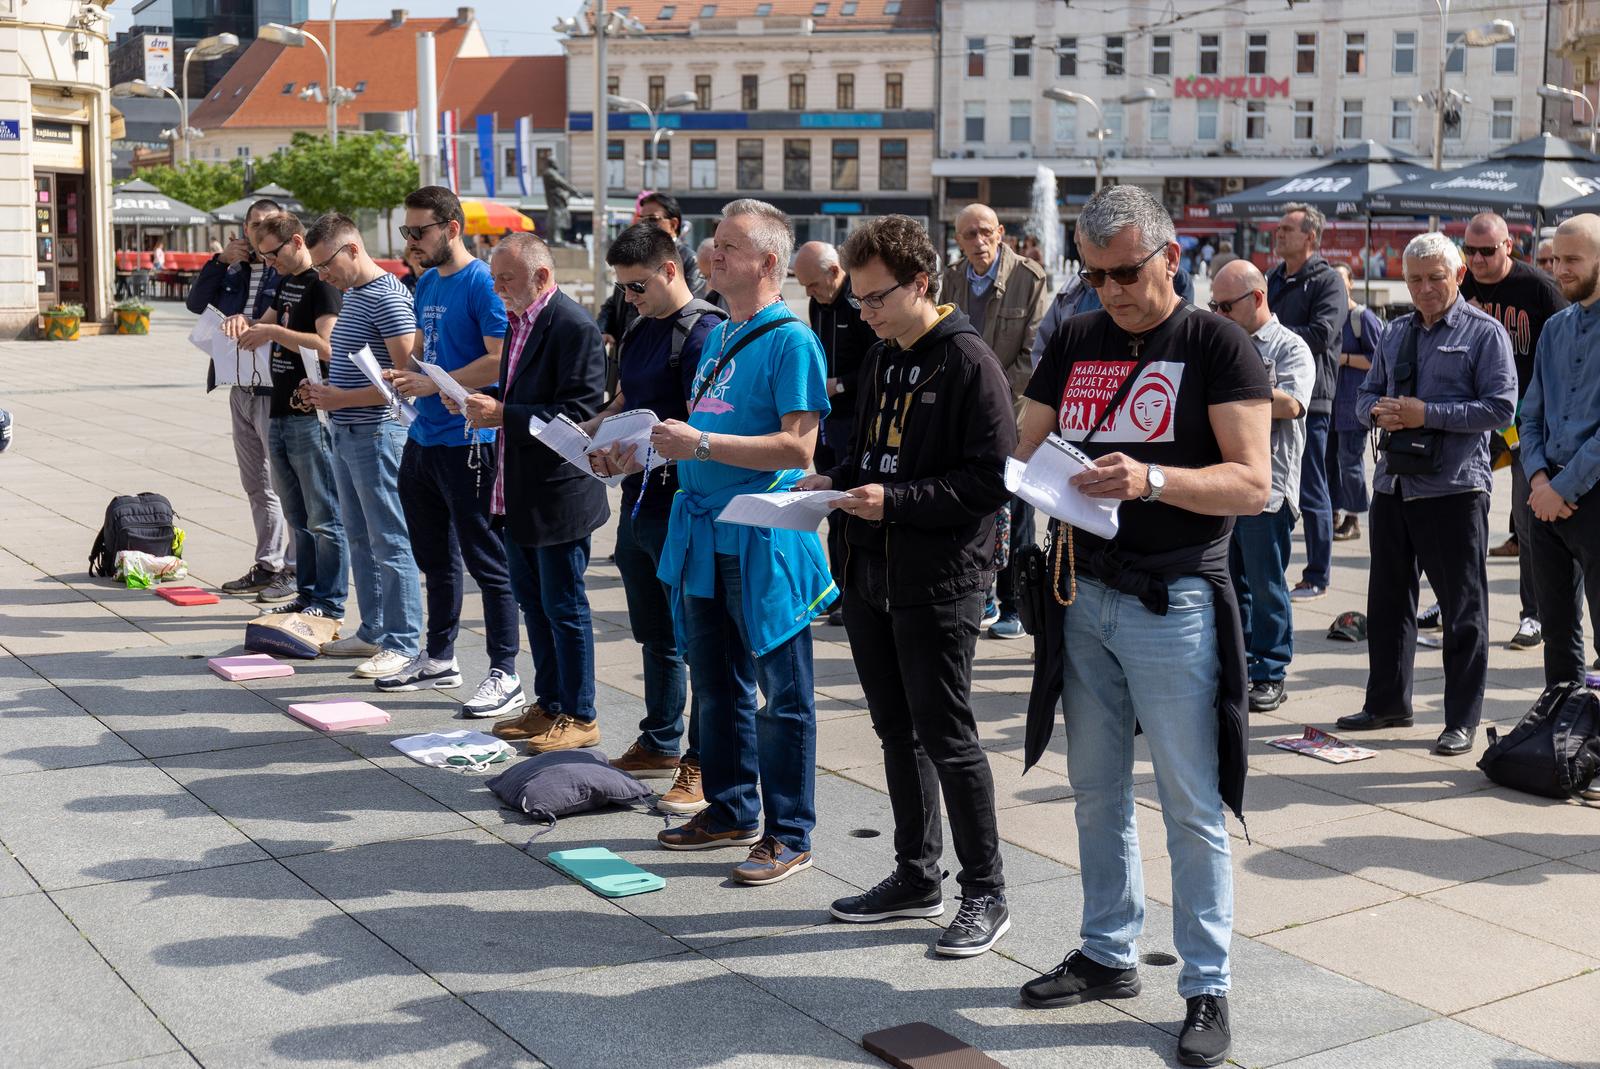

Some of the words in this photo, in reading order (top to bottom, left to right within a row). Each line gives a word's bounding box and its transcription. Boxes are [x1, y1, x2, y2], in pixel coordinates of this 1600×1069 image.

[151, 38, 168, 48] dm
[1174, 77, 1289, 98] KONZUM
[1073, 365, 1130, 377] MARIJANSKI
[1070, 376, 1105, 387] ZAVJET
[1105, 378, 1119, 389] ZA
[1066, 387, 1118, 401] DOMOVIN
